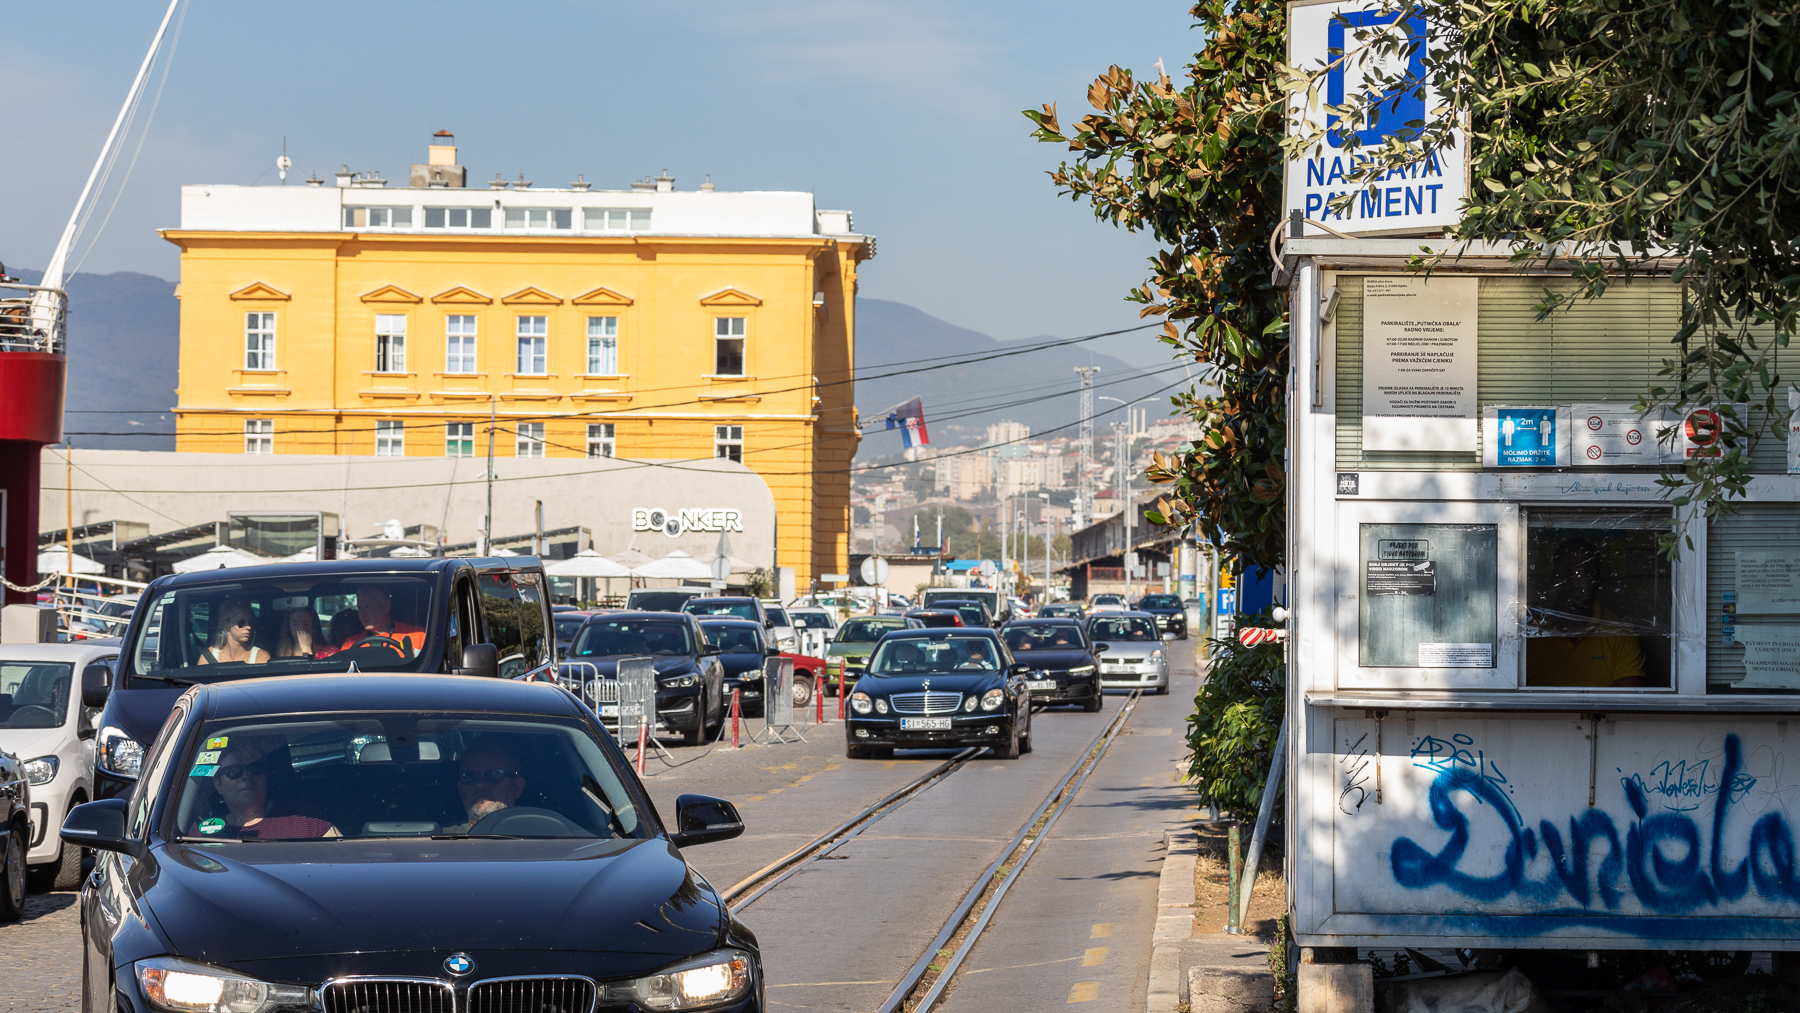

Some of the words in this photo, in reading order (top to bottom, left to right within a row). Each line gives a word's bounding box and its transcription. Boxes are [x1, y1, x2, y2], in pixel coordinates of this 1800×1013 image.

[634, 509, 741, 536] BOONKER
[1223, 593, 1234, 610] P
[922, 720, 949, 728] 565-HG
